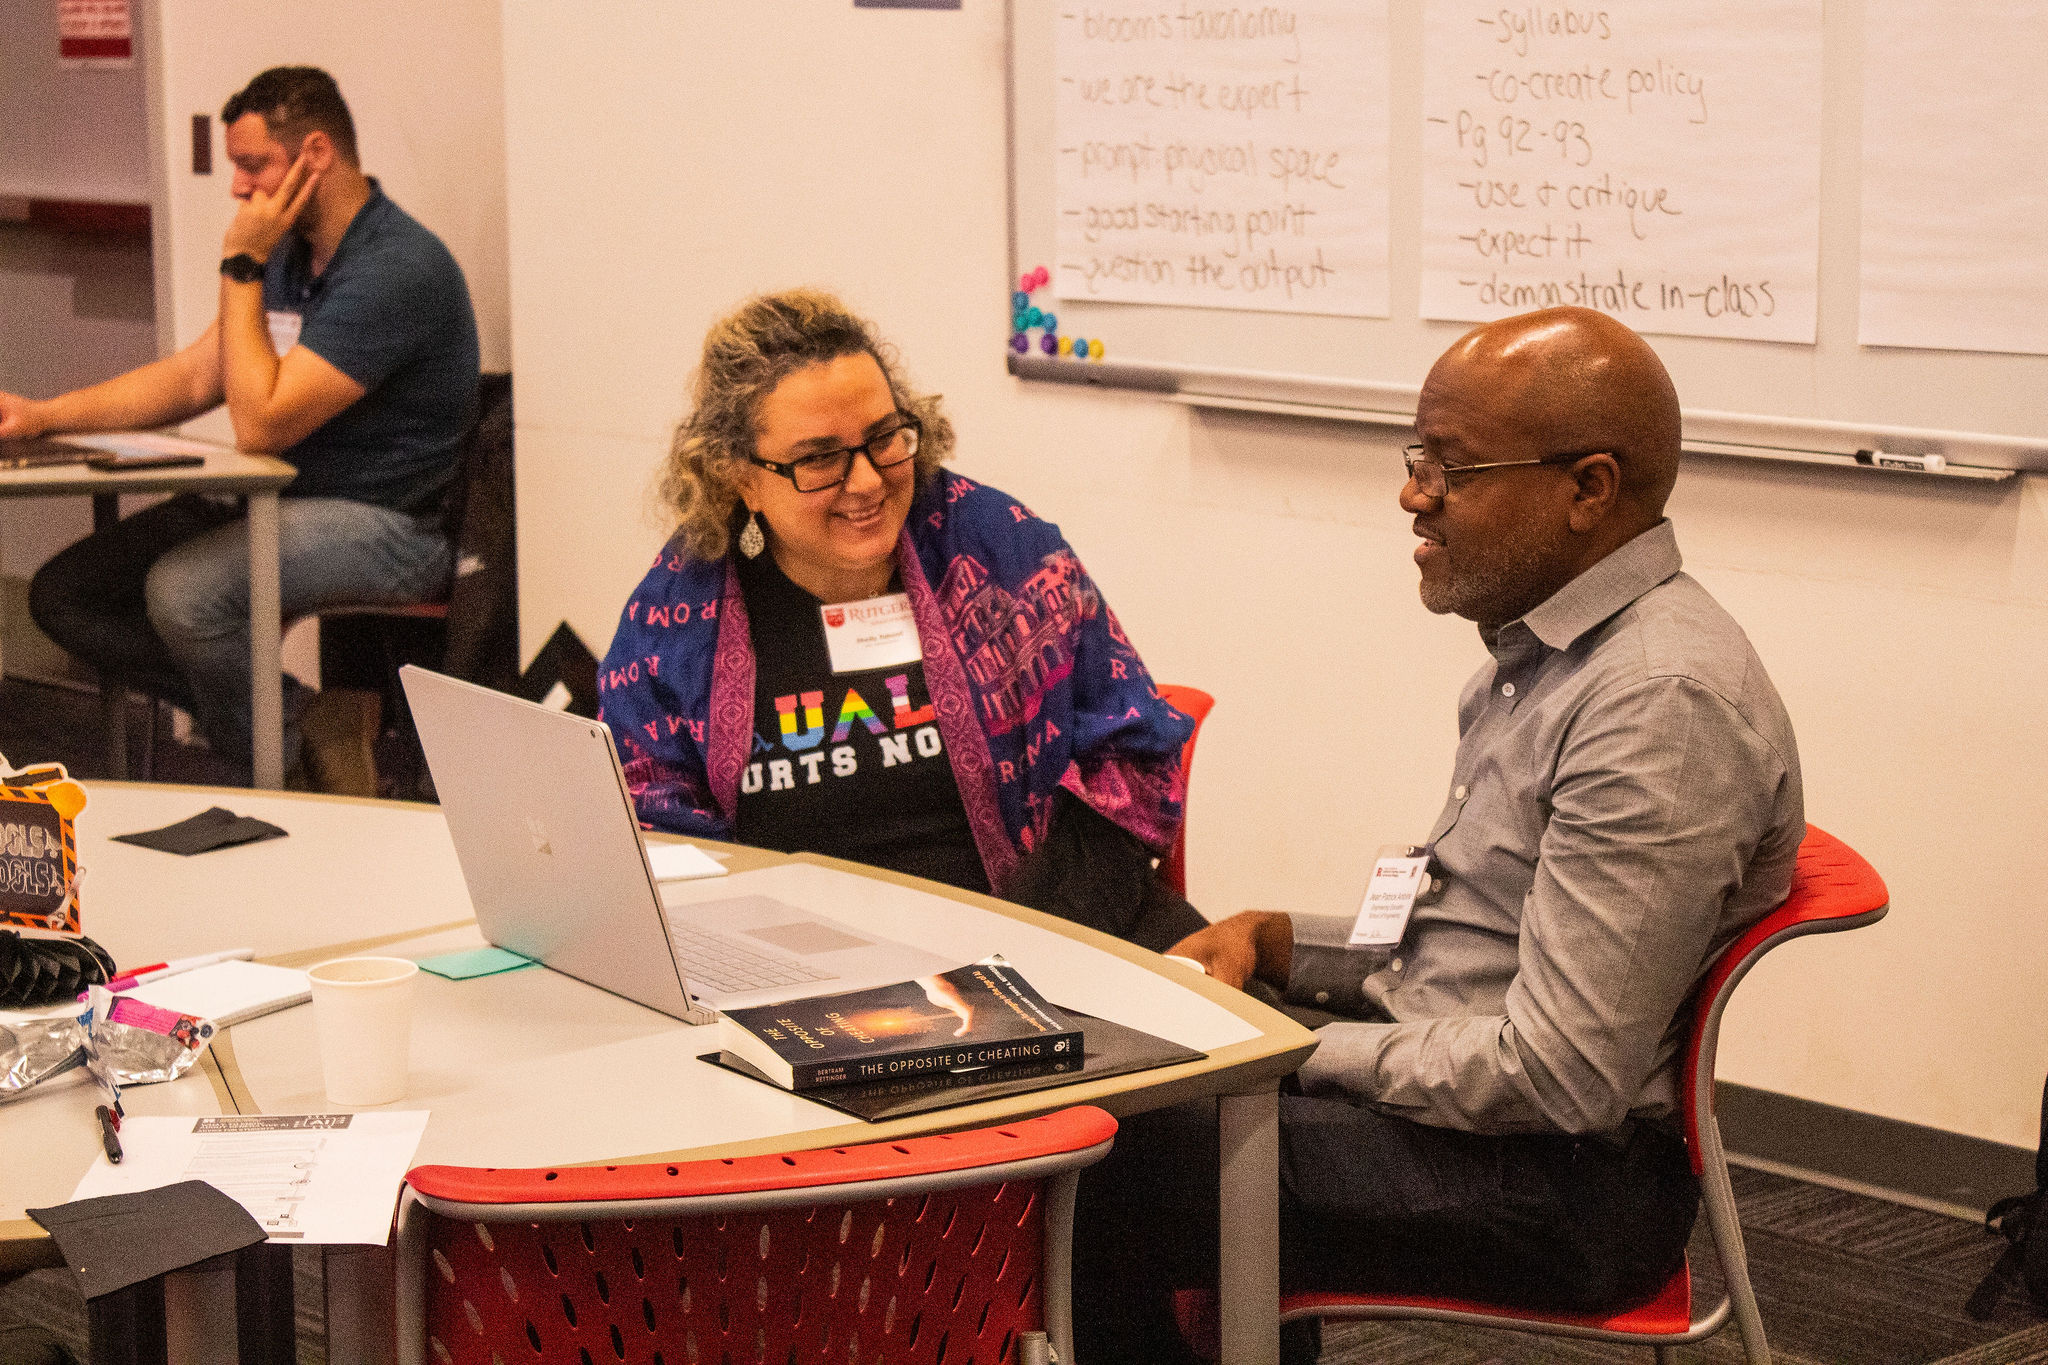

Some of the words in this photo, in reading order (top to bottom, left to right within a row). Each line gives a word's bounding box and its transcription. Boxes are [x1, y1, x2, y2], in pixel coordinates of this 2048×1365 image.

[1218, 73, 1310, 120] expert
[1627, 58, 1707, 124] policy
[1164, 140, 1257, 193] physical
[1269, 146, 1346, 191] space
[1566, 174, 1682, 241] critique
[1144, 203, 1238, 259] starting
[1246, 203, 1317, 252] point
[1565, 222, 1593, 258] it
[1185, 253, 1236, 290] the
[1239, 248, 1336, 300] output
[879, 726, 943, 768] NO
[763, 1028, 788, 1041] THE
[776, 1018, 825, 1049] OPPOSITE
[814, 1027, 835, 1036] OF
[825, 1012, 875, 1044] CHEATING
[860, 1064, 884, 1076] THE
[889, 1054, 952, 1073] OPPOSITE
[957, 1052, 974, 1065] OF
[978, 1045, 1041, 1062] CHEATING
